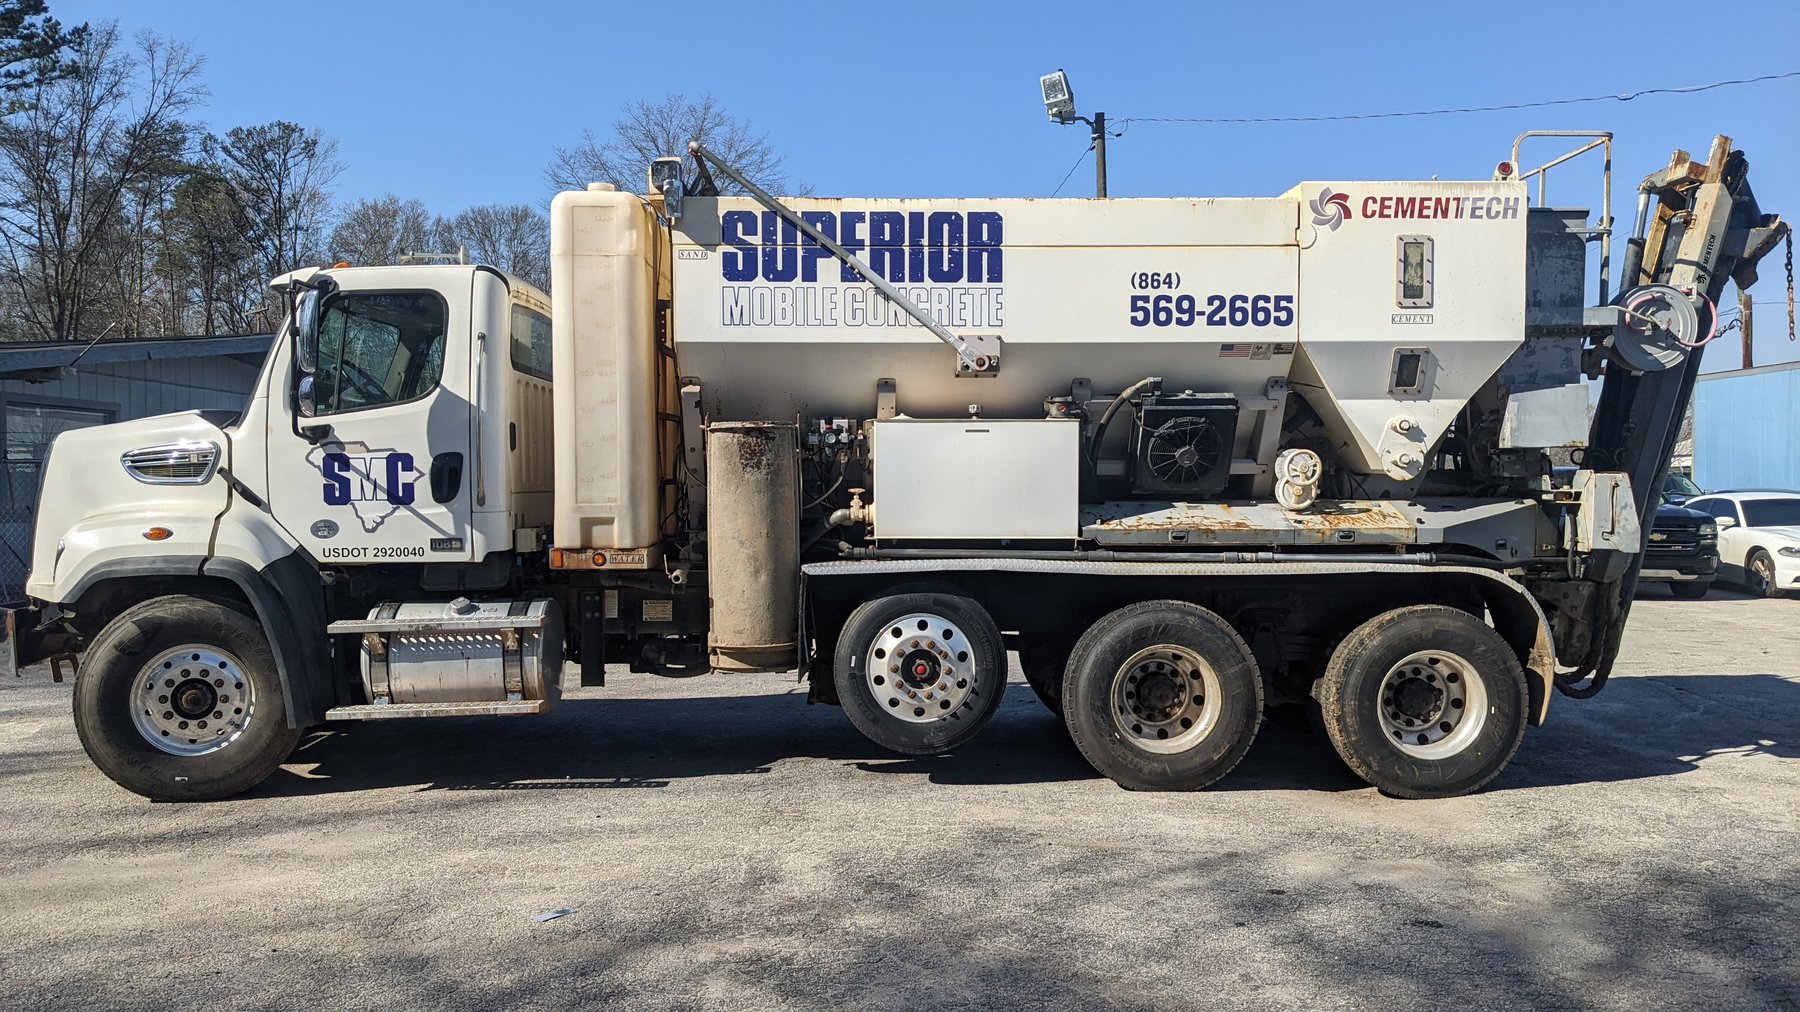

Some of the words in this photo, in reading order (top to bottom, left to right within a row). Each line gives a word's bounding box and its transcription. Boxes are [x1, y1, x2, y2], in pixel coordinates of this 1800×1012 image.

[1361, 196, 1520, 220] CEMENTECH
[722, 210, 1003, 282] SUPERIOR
[1700, 234, 1717, 273] CEMENTECH
[1130, 272, 1181, 290] (864)
[722, 286, 838, 327] MOBILE
[844, 287, 1004, 327] CONCRETE
[1130, 294, 1294, 327] 569-2665
[1392, 315, 1433, 323] CEMENT
[322, 452, 416, 506] SMC
[322, 547, 369, 558] USDOT
[373, 547, 425, 558] 2920040
[611, 555, 644, 563] WATER
